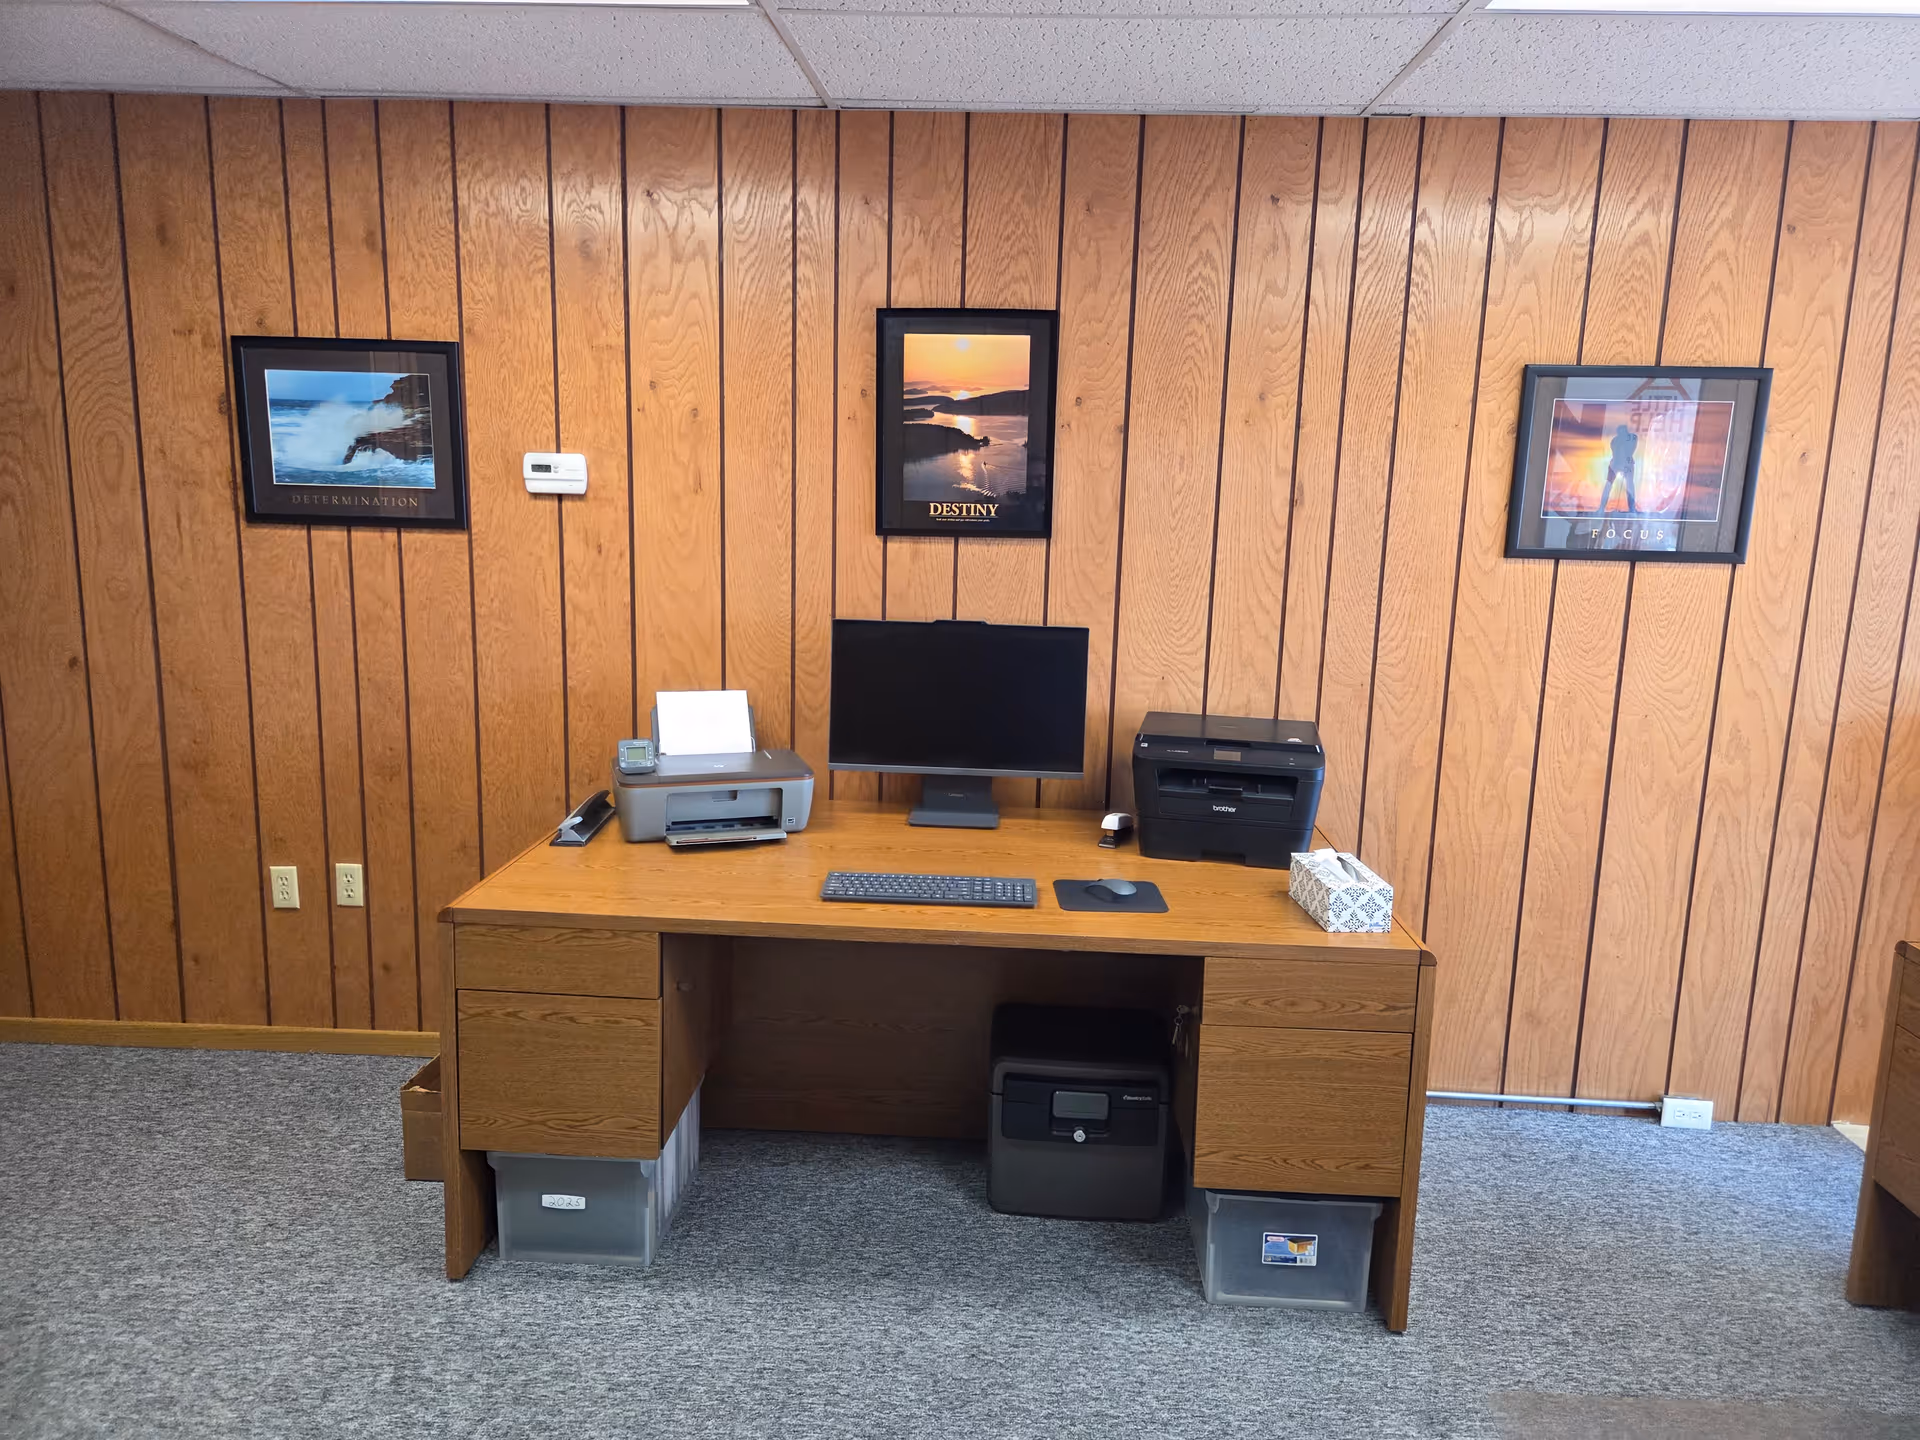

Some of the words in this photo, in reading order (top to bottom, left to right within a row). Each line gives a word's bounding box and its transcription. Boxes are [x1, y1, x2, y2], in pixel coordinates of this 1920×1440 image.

[292, 494, 418, 507] DETERMINATION
[929, 502, 999, 517] DESTINY
[1591, 528, 1664, 540] FOCUS
[1212, 804, 1237, 813] brother
[548, 1195, 583, 1207] 2025
